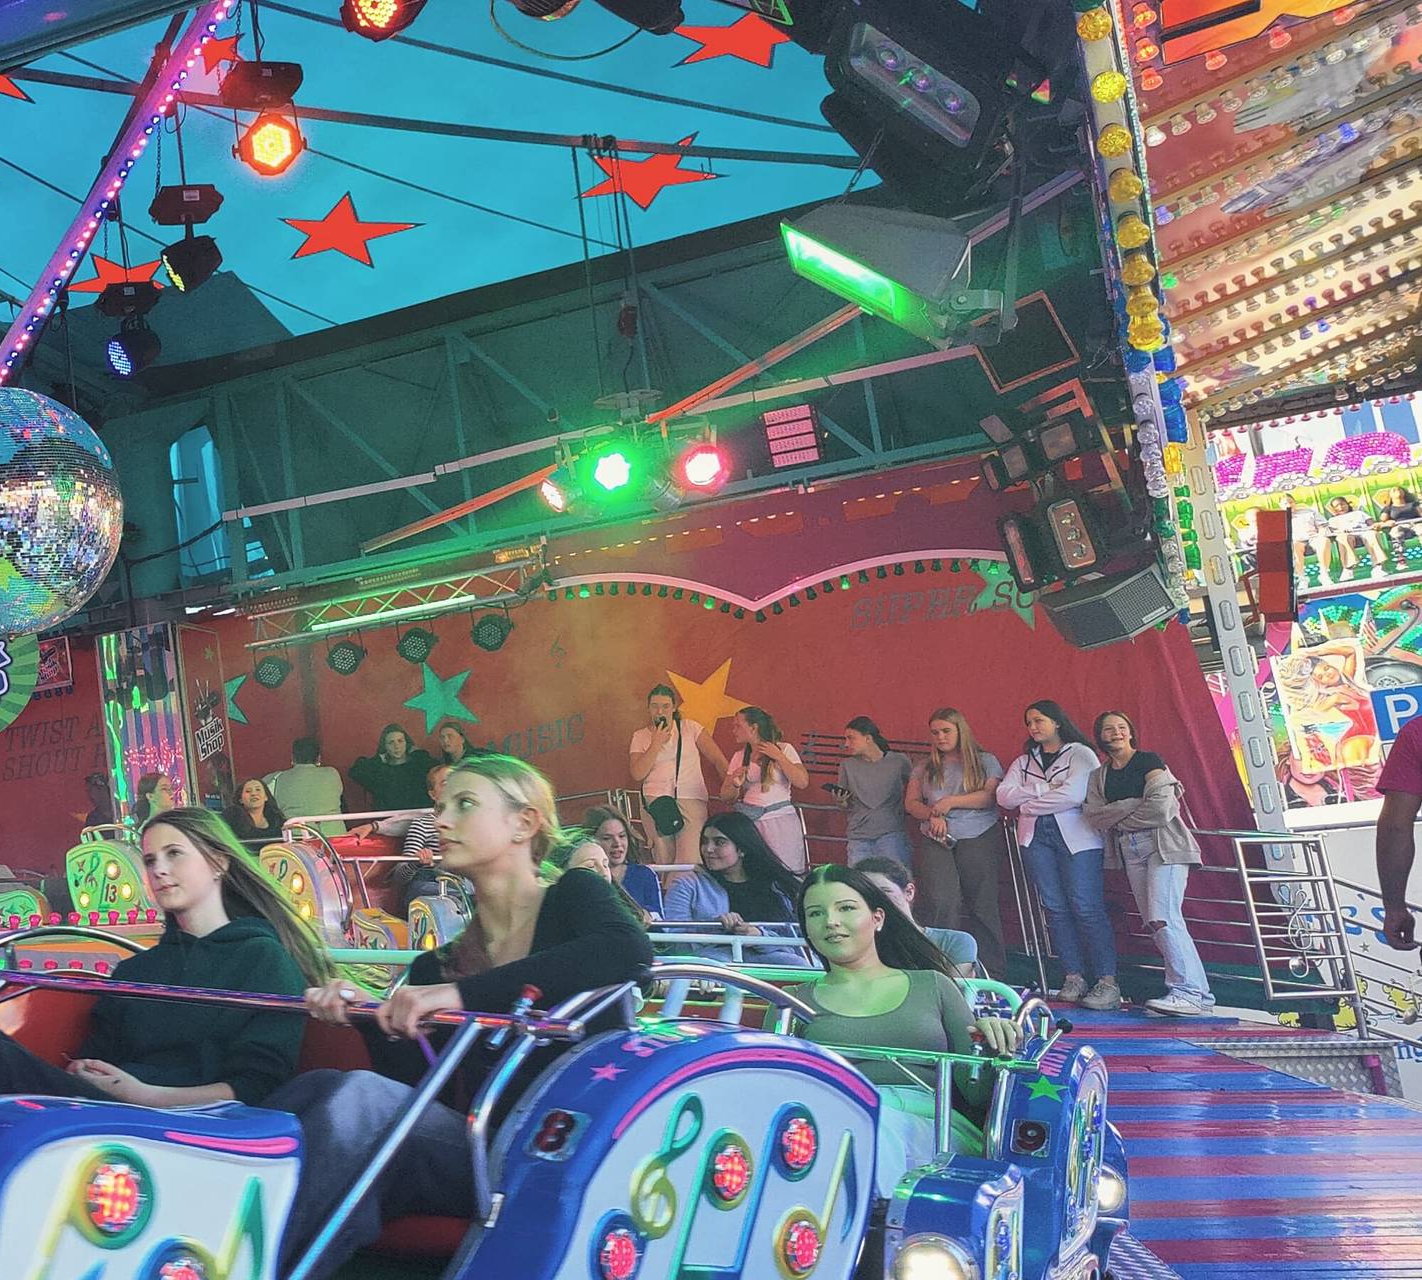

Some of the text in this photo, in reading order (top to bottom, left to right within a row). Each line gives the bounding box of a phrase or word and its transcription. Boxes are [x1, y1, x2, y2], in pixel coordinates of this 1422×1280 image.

[1384, 693, 1418, 734] P
[195, 717, 224, 746] Musik
[105, 883, 118, 903] 13
[534, 1111, 575, 1151] 8
[1017, 1120, 1047, 1152] 9
